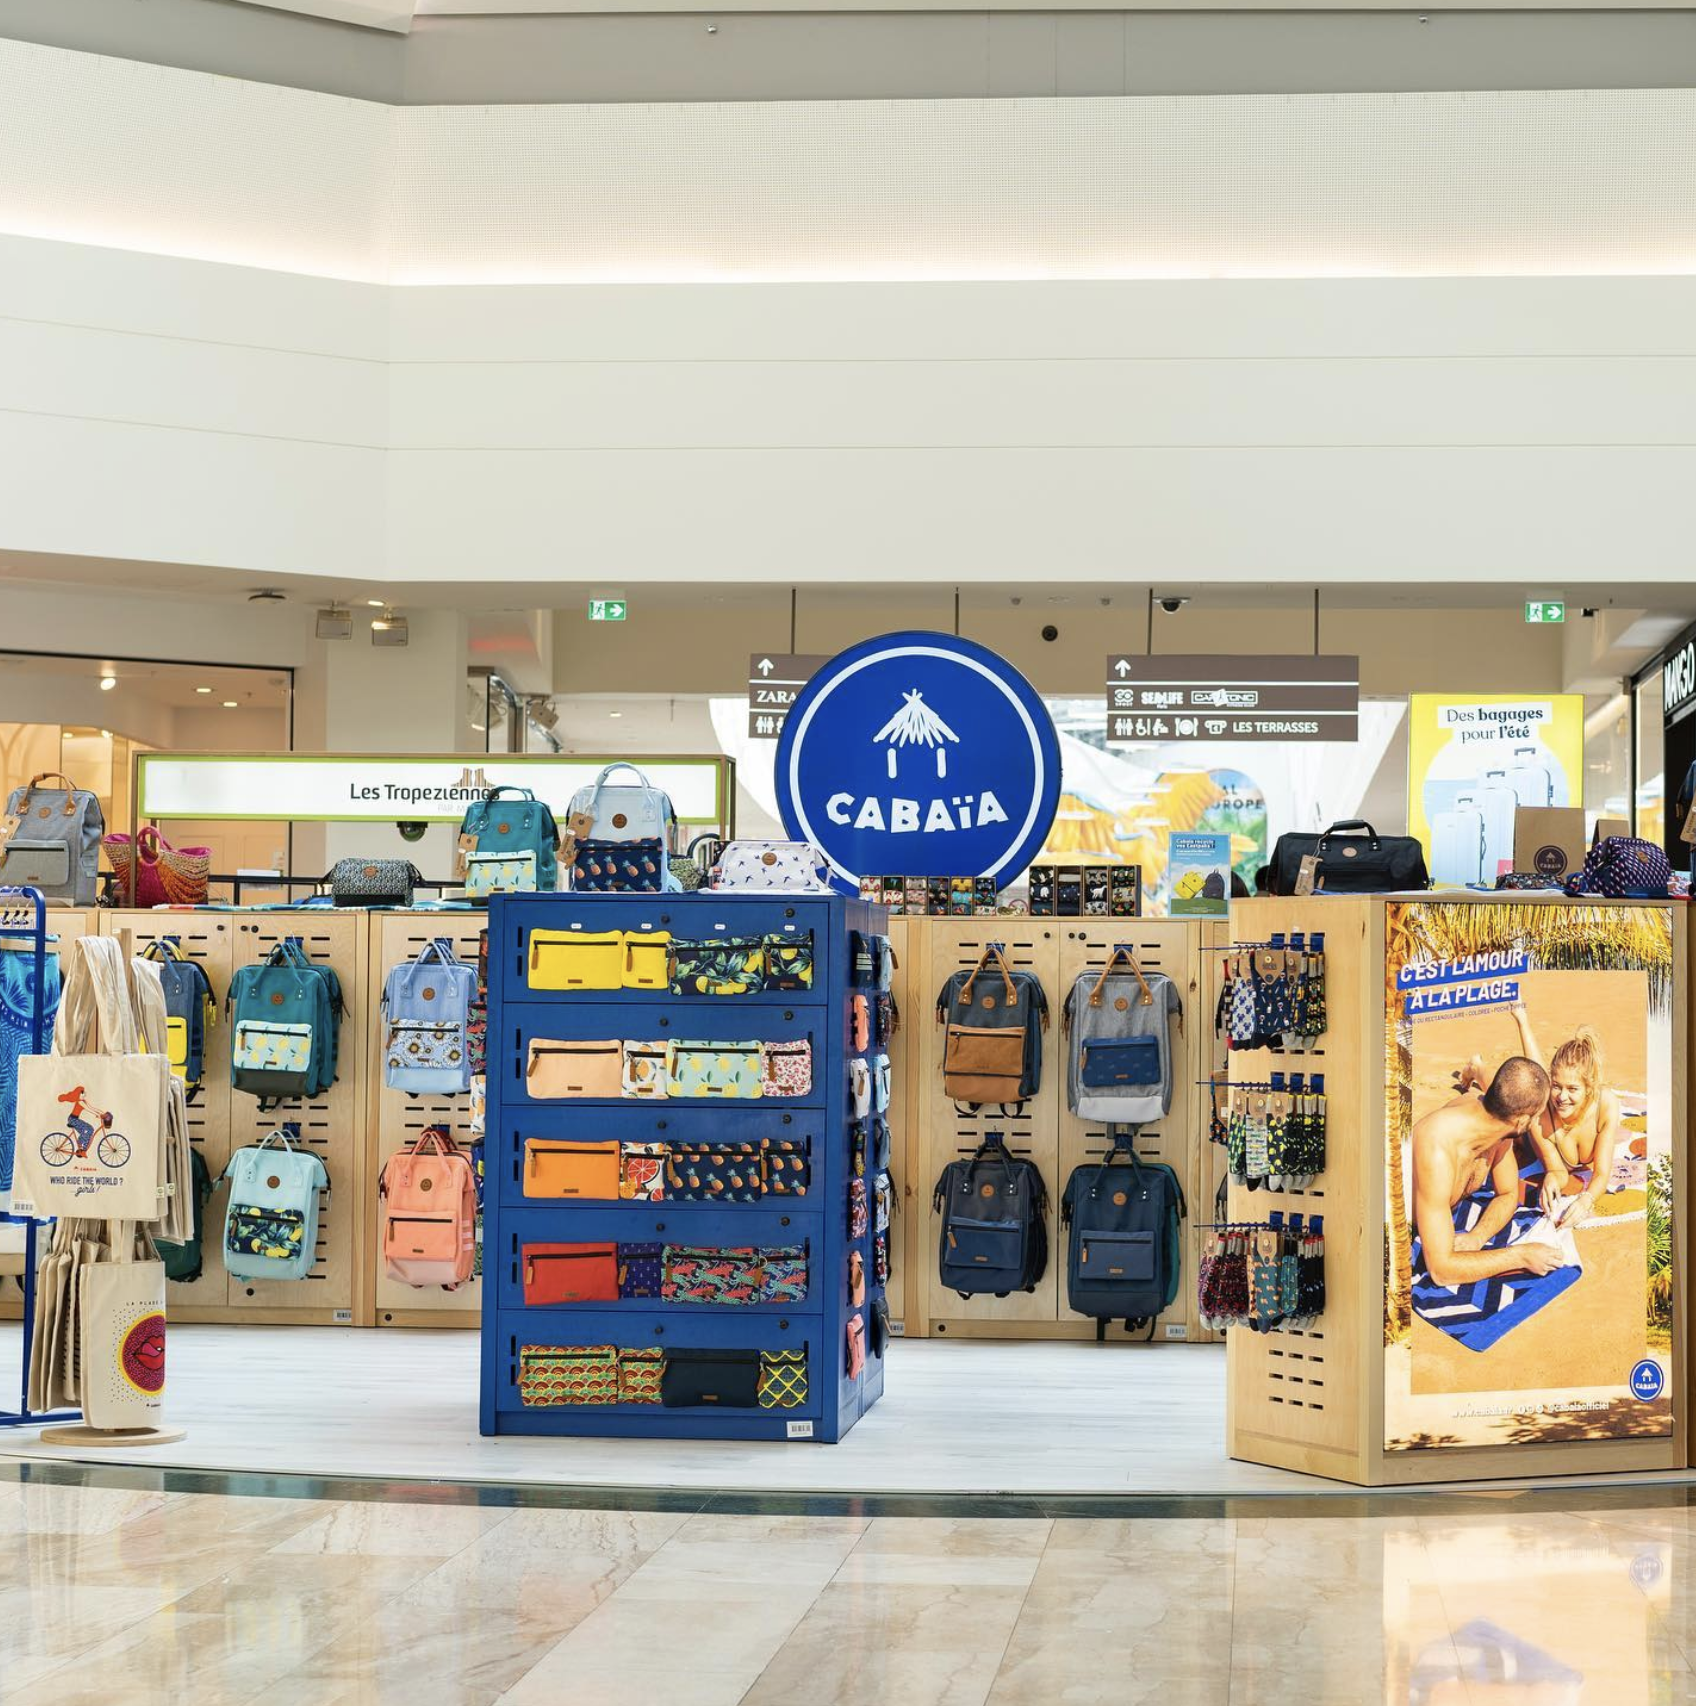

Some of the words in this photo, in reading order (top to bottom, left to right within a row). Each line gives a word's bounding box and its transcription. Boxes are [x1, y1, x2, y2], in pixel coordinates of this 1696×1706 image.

[1664, 642, 1695, 712] MANGO
[756, 690, 797, 703] ZARA
[1447, 709, 1475, 722] Des
[1478, 708, 1543, 723] bagages
[1232, 721, 1252, 733] LES
[1254, 721, 1319, 733] TERRASSES
[1462, 730, 1496, 744] pour
[1499, 725, 1530, 739] l'été
[350, 783, 380, 800] Les
[1400, 960, 1448, 982] C'EST
[1452, 949, 1523, 976] L'AMOUR
[1427, 987, 1451, 1007] LA
[1455, 979, 1516, 1004] PLAGE.
[50, 1176, 65, 1185] WHO
[66, 1176, 81, 1185] RIDE
[82, 1176, 94, 1185] THE
[95, 1176, 118, 1186] WORLD
[119, 1177, 124, 1186] ?
